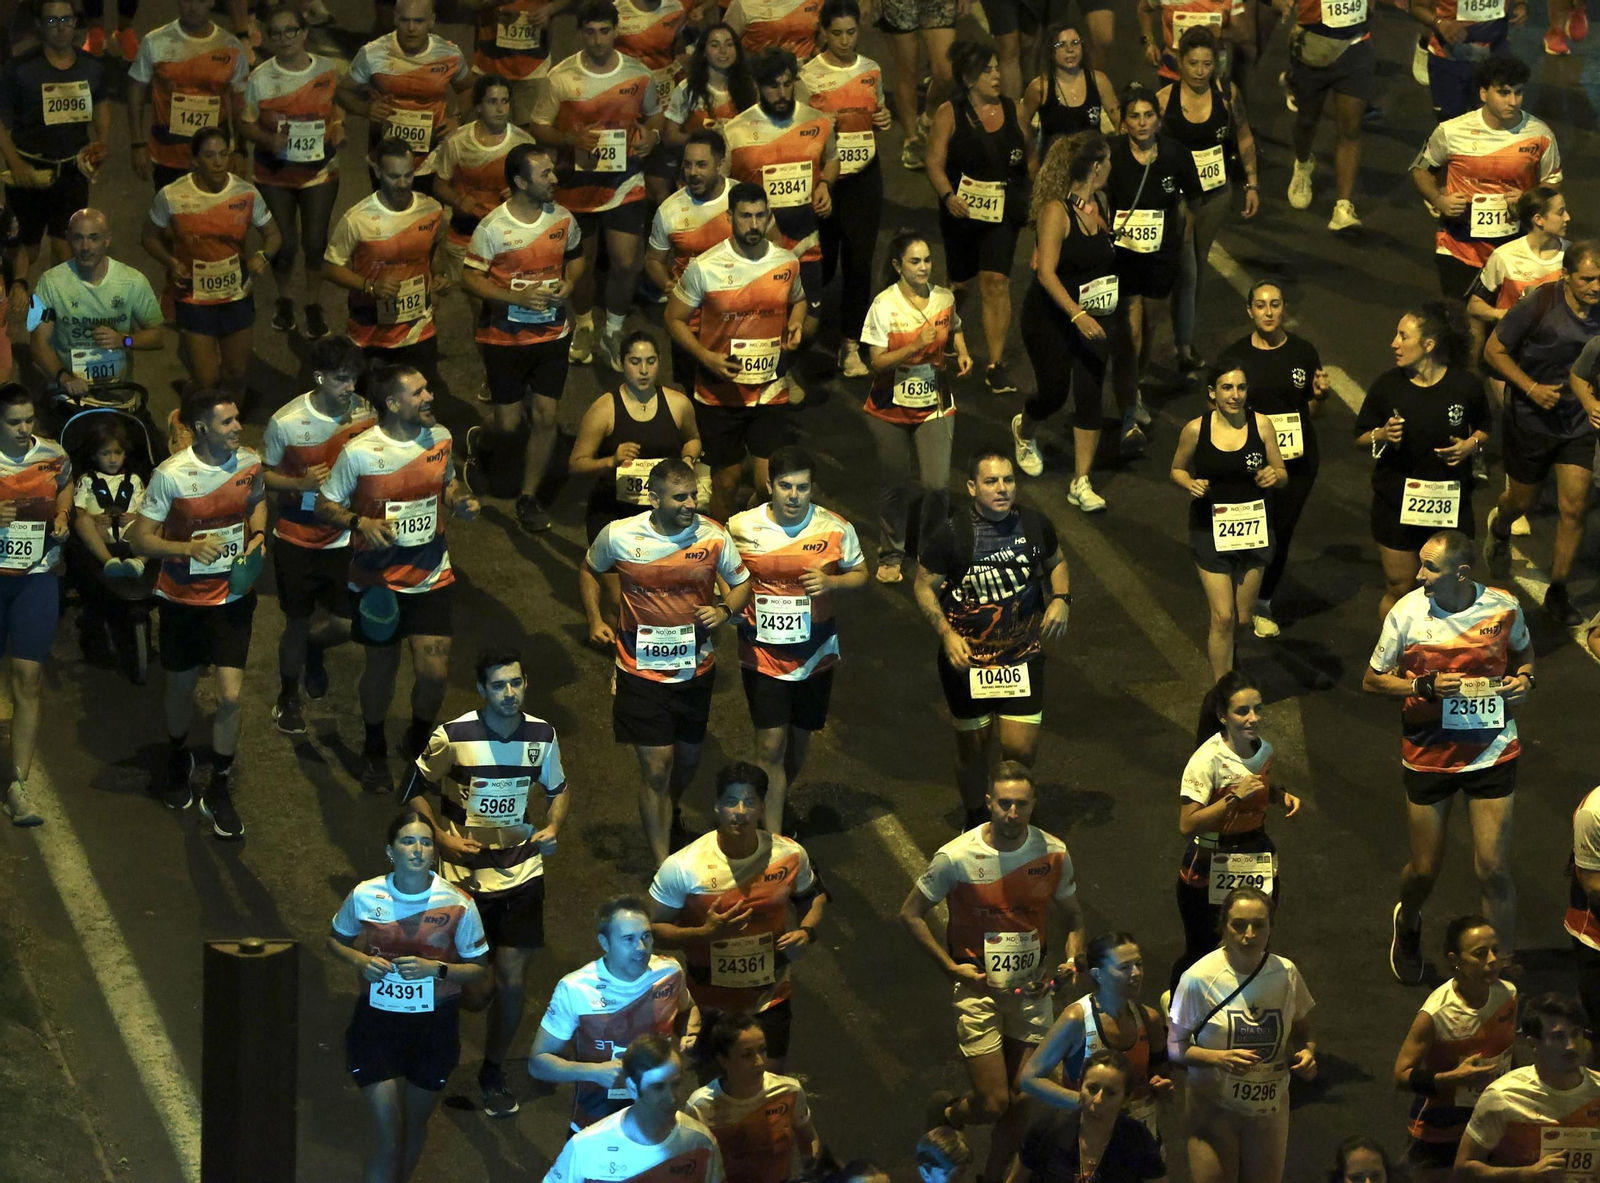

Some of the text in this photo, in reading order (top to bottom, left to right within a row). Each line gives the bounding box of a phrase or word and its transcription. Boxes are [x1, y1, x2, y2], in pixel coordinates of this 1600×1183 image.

[1327, 1, 1362, 17] 18549
[48, 99, 86, 113] 20996
[180, 112, 210, 126] 1427
[388, 124, 425, 141] 10960
[287, 138, 316, 151] 1432
[769, 179, 807, 195] 23841
[199, 275, 237, 291] 10958
[84, 363, 115, 380] 1801
[1278, 433, 1294, 448] 21
[1408, 498, 1452, 514] 22238
[1219, 520, 1260, 538] 24277
[760, 615, 802, 631] 24321
[642, 644, 688, 659] 18940
[976, 668, 1021, 684] 10406
[1449, 698, 1496, 716] 23515
[479, 798, 515, 815] 5968
[1216, 873, 1264, 891] 22799
[717, 958, 765, 974] 24361
[991, 954, 1034, 973] 24360
[376, 981, 423, 999] 24391
[1231, 1082, 1277, 1101] 19296
